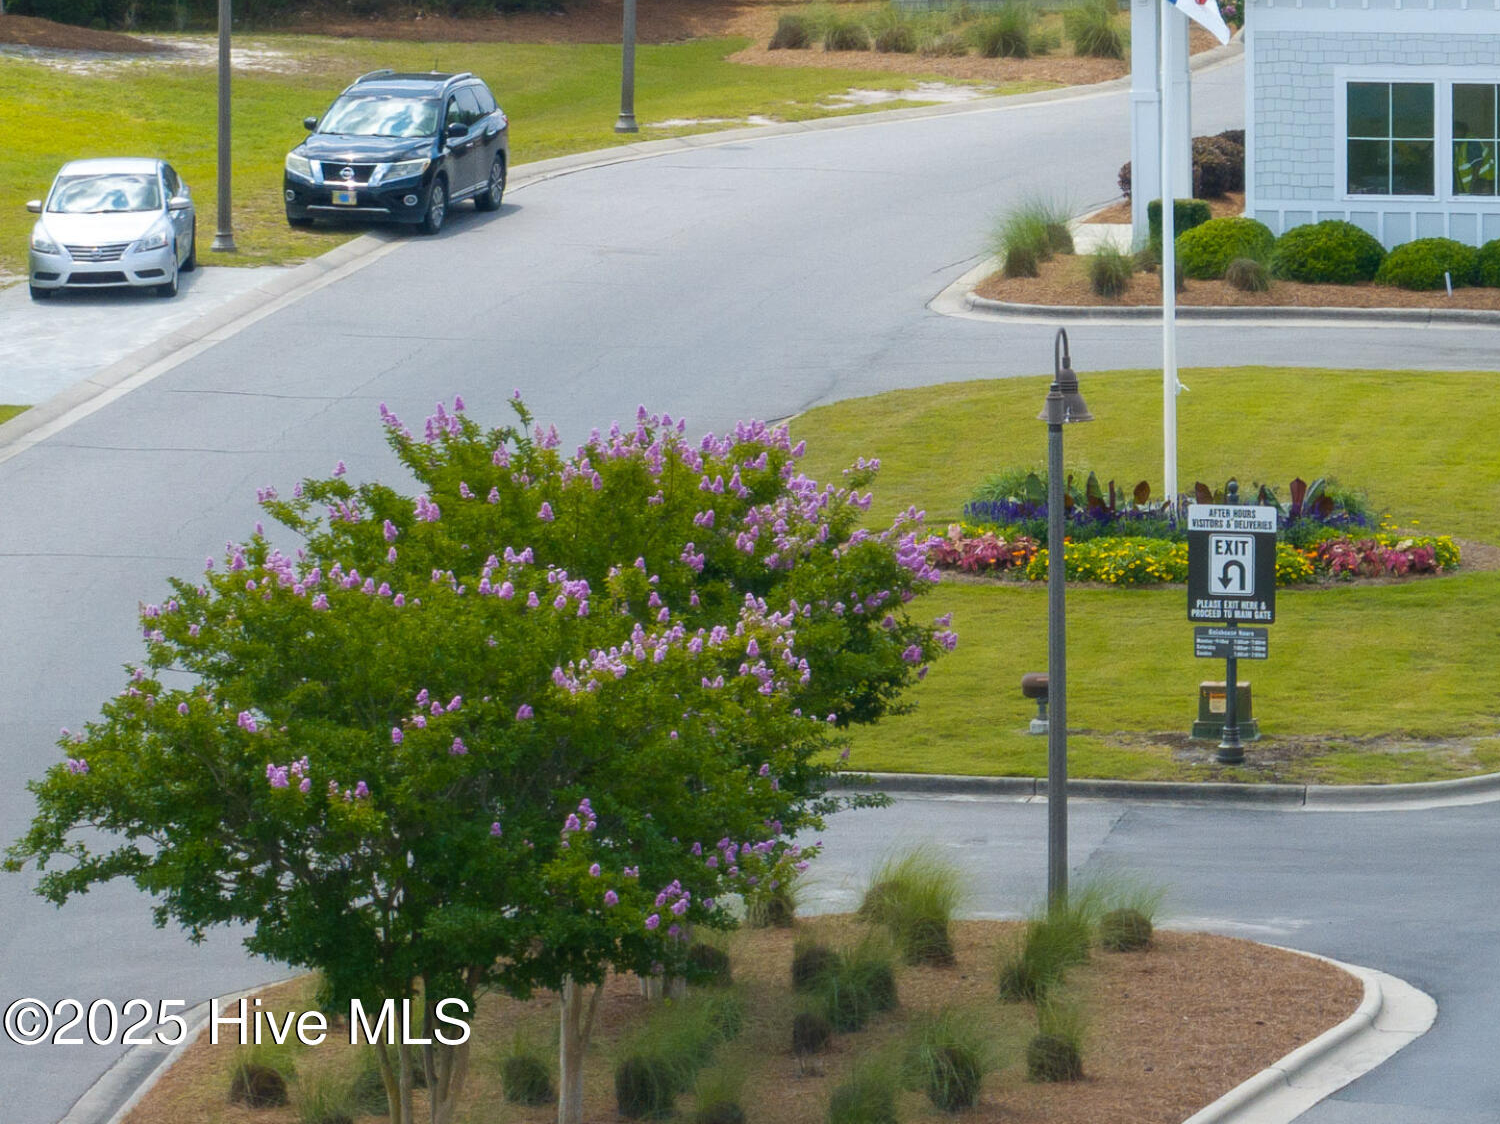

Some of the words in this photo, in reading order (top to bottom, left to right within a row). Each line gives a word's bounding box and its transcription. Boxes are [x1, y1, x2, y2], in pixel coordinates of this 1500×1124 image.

[1209, 508, 1230, 518] AFTER
[1233, 509, 1256, 519] HOURS
[1192, 519, 1224, 528] VISITORS
[1234, 519, 1272, 530] DELIVERIES
[1215, 540, 1249, 556] EXIT
[1196, 599, 1222, 608] PLEASE
[1224, 600, 1239, 609] EXIT
[1241, 601, 1258, 610] HERE
[1191, 609, 1221, 618] PROCEED
[1224, 610, 1233, 619] TO
[1234, 610, 1252, 619] MAIN
[1254, 611, 1272, 620] GATE
